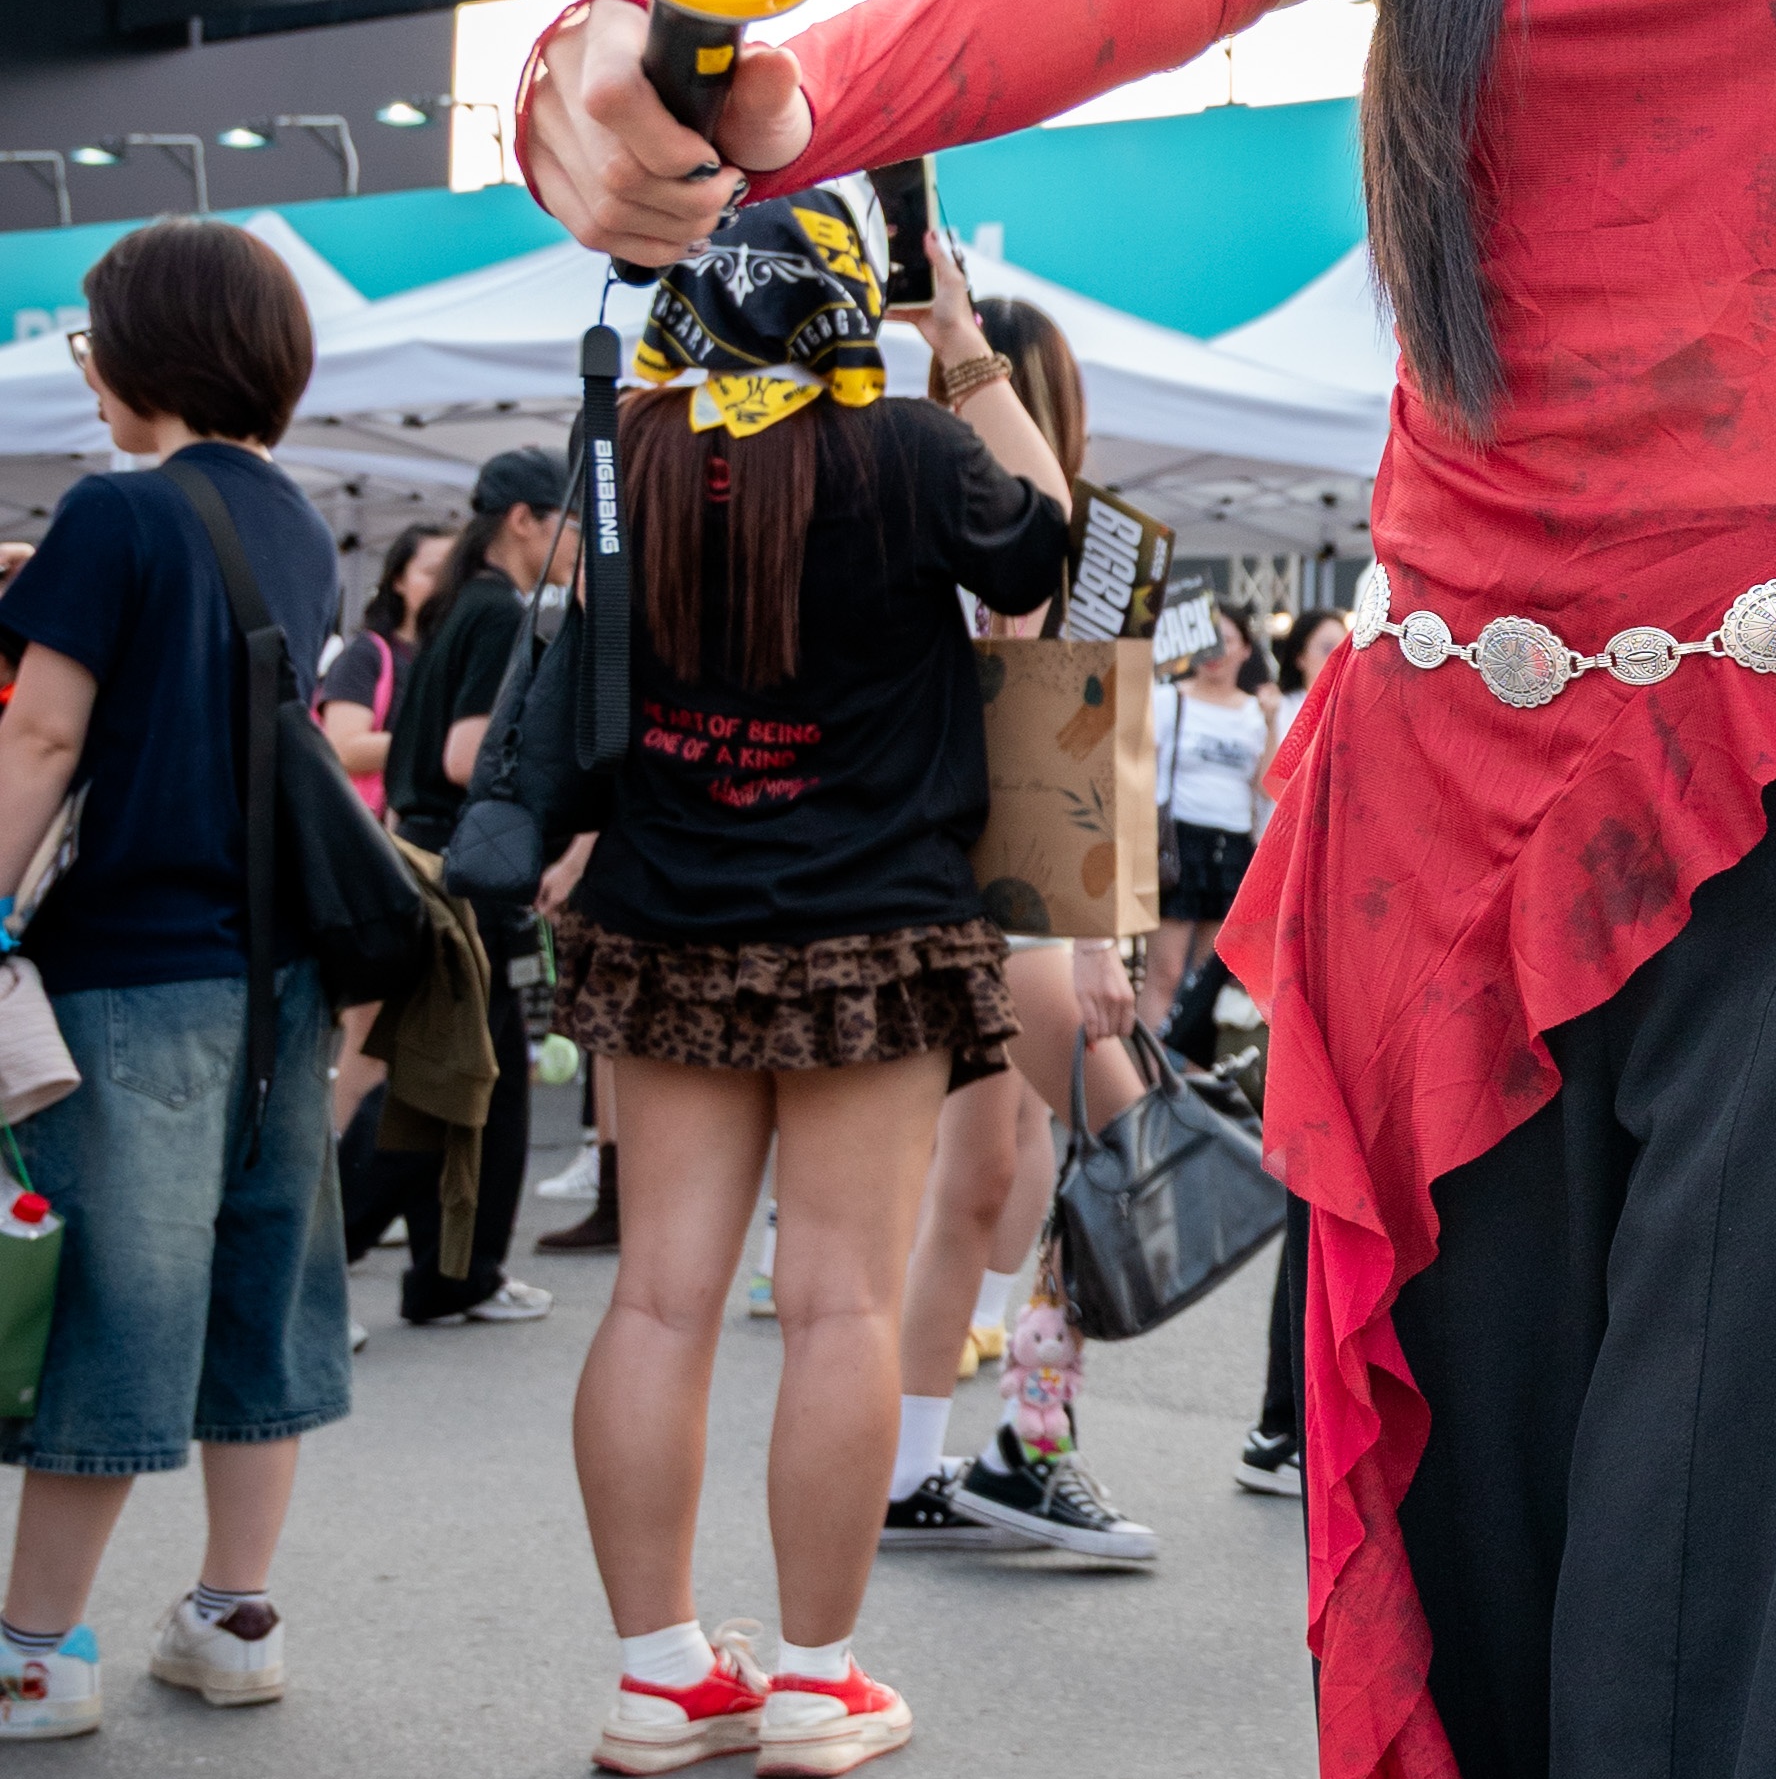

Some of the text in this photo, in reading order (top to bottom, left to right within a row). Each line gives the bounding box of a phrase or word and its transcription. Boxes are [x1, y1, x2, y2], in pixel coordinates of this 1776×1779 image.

[708, 714, 743, 738] OF
[748, 719, 822, 744] BEING
[681, 736, 710, 762] OF
[715, 743, 735, 766] A
[739, 747, 797, 769] KIND
